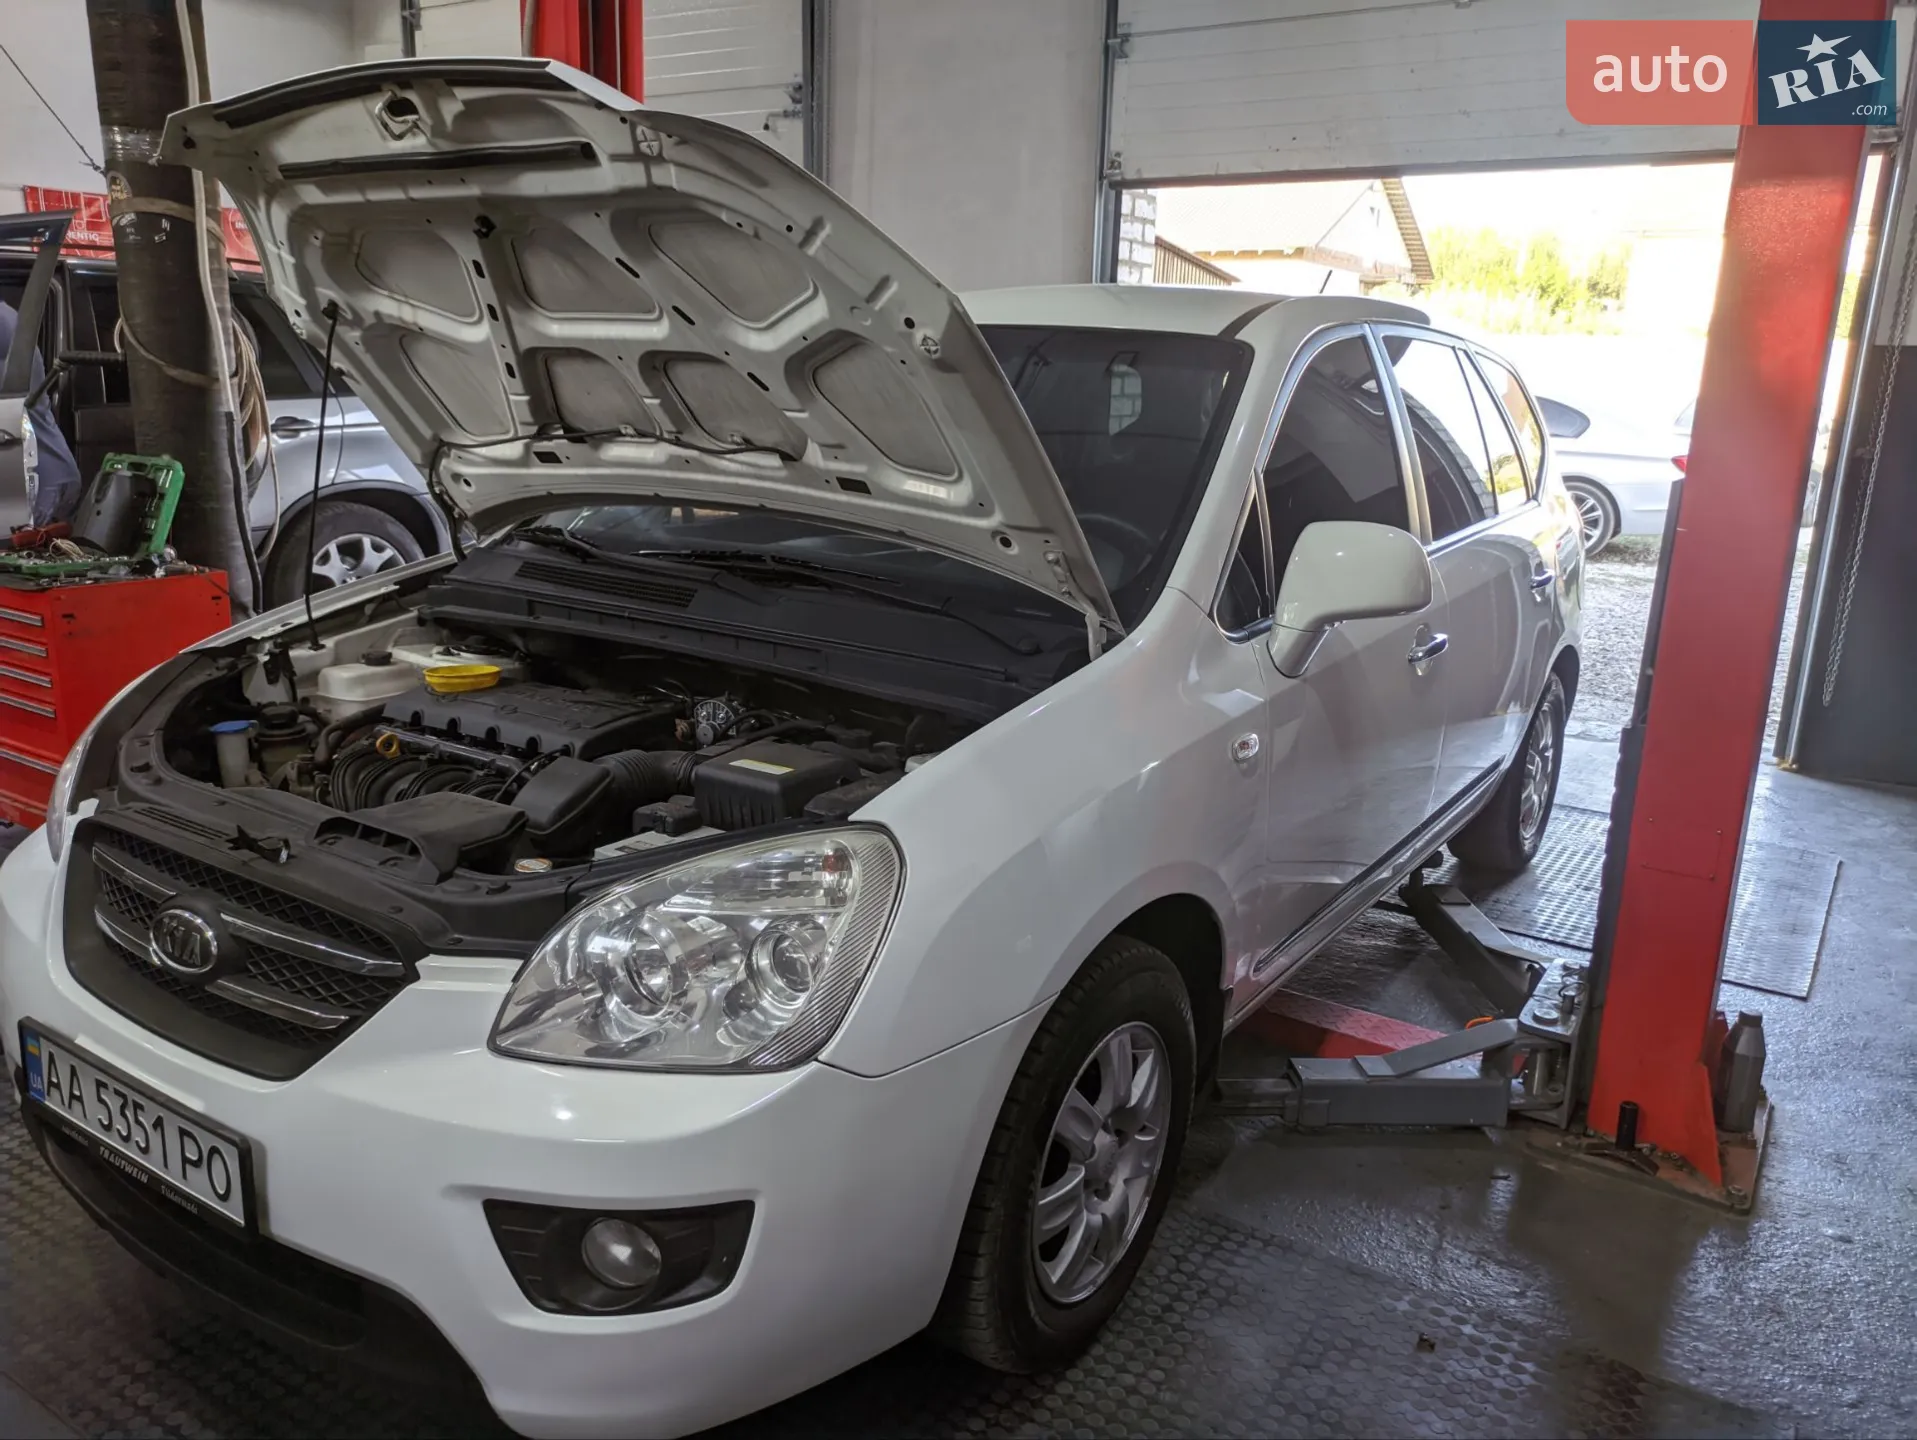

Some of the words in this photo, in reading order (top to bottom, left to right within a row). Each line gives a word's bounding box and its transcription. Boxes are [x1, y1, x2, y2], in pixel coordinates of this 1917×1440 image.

[30, 1072, 44, 1092] UA
[46, 1049, 88, 1121] AA
[94, 1077, 169, 1170] 5351
[177, 1124, 232, 1203] PO
[100, 1145, 149, 1184] TRAUTWEIN
